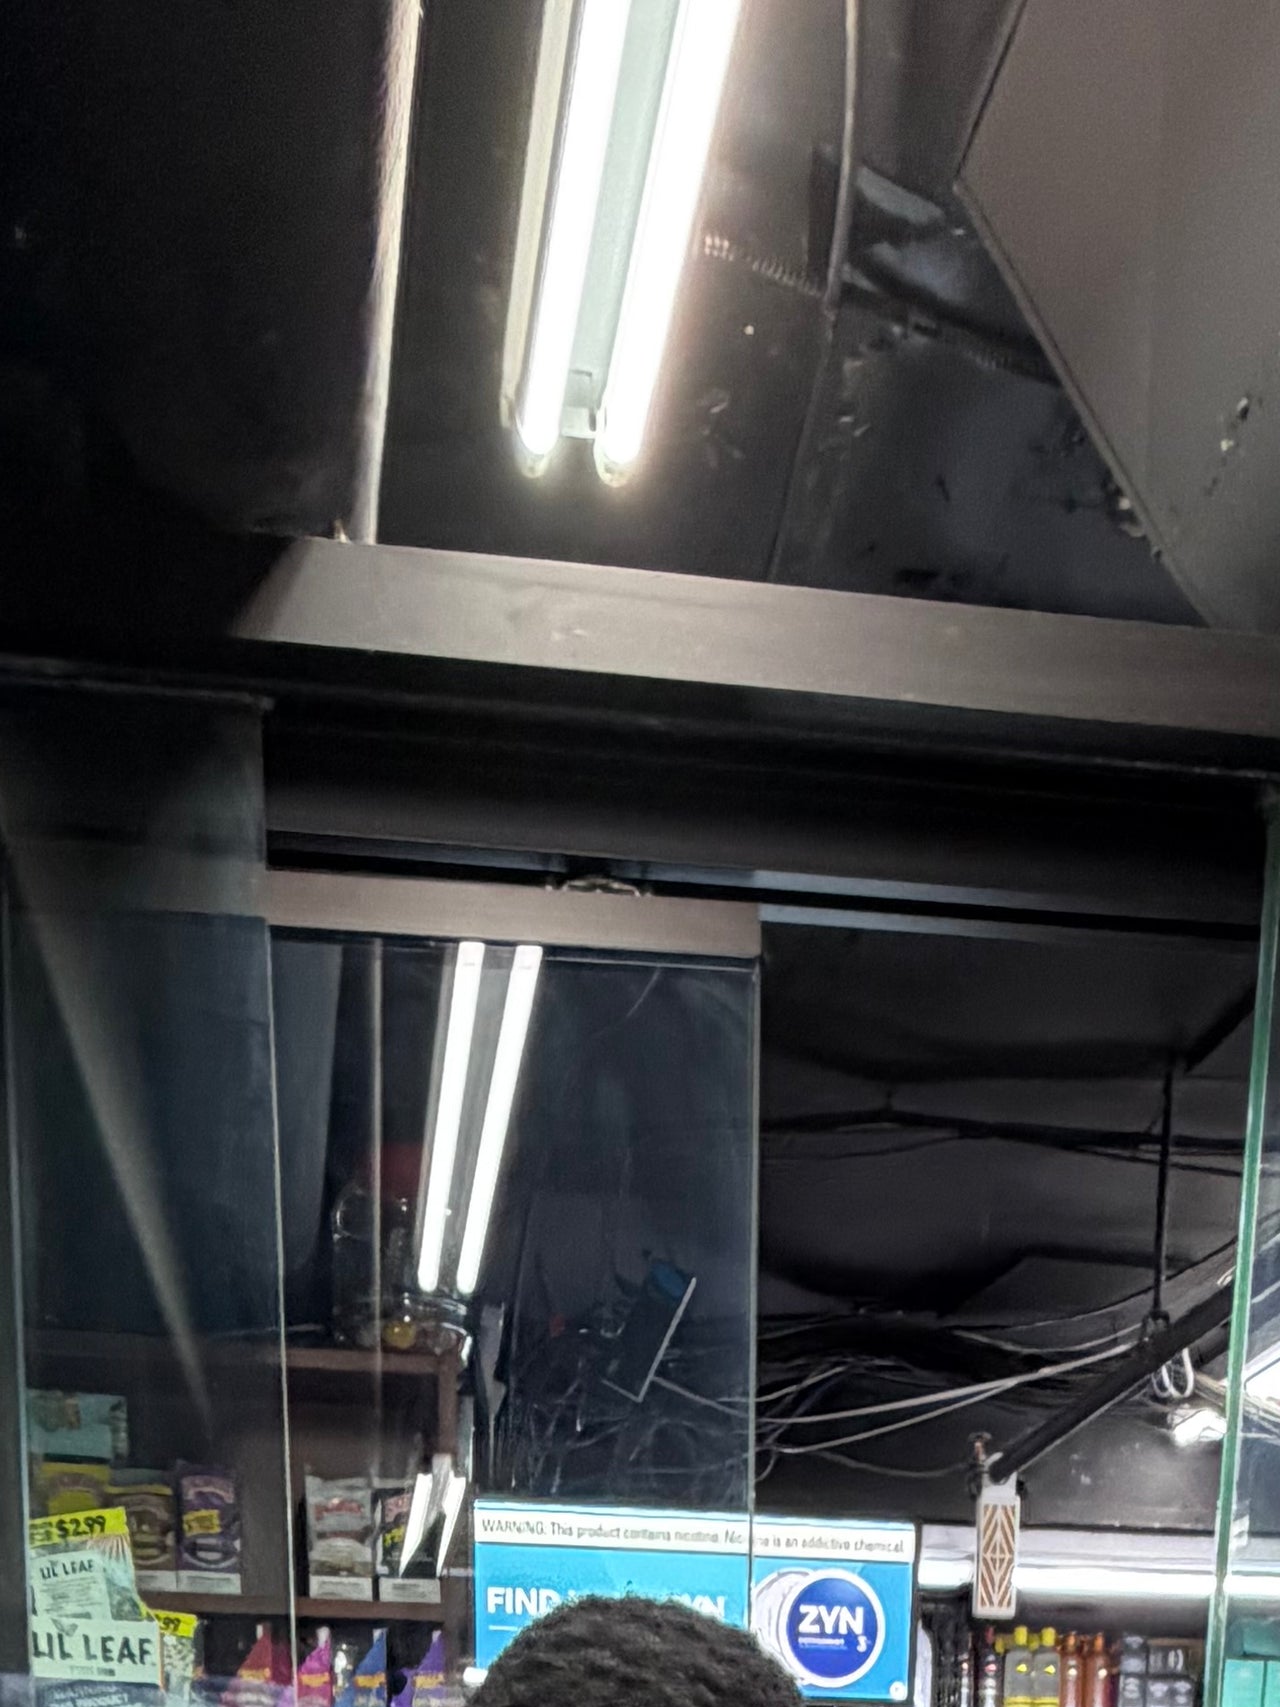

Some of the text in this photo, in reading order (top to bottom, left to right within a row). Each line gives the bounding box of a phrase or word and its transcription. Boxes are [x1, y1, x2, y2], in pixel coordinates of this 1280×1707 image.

[55, 1515, 107, 1538] $2.99
[550, 1521, 573, 1536] This
[577, 1524, 620, 1540] product
[62, 1559, 94, 1576] LEAF
[486, 1586, 560, 1616] FIND
[798, 1603, 864, 1635] ZYN
[32, 1631, 154, 1666] LIL LEAF
